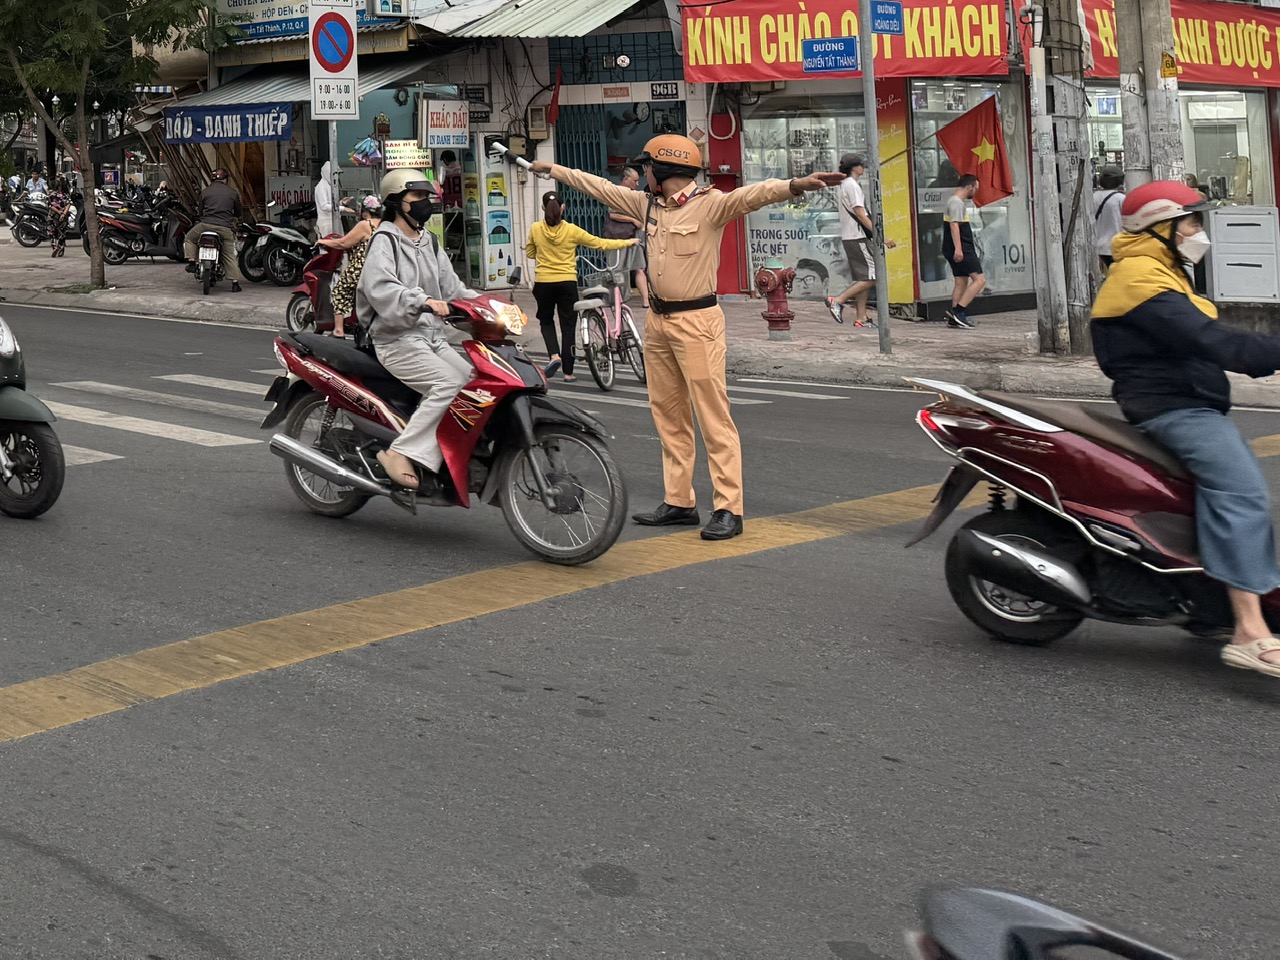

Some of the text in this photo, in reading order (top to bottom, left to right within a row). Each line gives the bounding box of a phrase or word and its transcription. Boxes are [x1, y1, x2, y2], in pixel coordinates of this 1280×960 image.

[261, 7, 276, 20] HỘP
[876, 3, 897, 15] ĐƯỜNG
[874, 17, 900, 32] HOÀNG DIỆU
[686, 5, 753, 66] KÍNH
[812, 41, 845, 52] ĐƯỜNG
[1215, 18, 1272, 79] ĐƯỢC
[803, 53, 856, 68] NGUYỄN TẤT THÀNH
[652, 84, 677, 95] 96B
[165, 111, 193, 139] DẤU
[204, 114, 241, 138] DANH
[246, 106, 288, 137] THIẾP
[430, 103, 468, 129] KHẮC DẤU
[429, 131, 468, 145] IN DANH THIẾP
[657, 148, 691, 160] CSGT
[750, 226, 812, 243] TRONG SUỐT,
[751, 239, 788, 255] SẮC NÉT
[1002, 243, 1026, 265] 101
